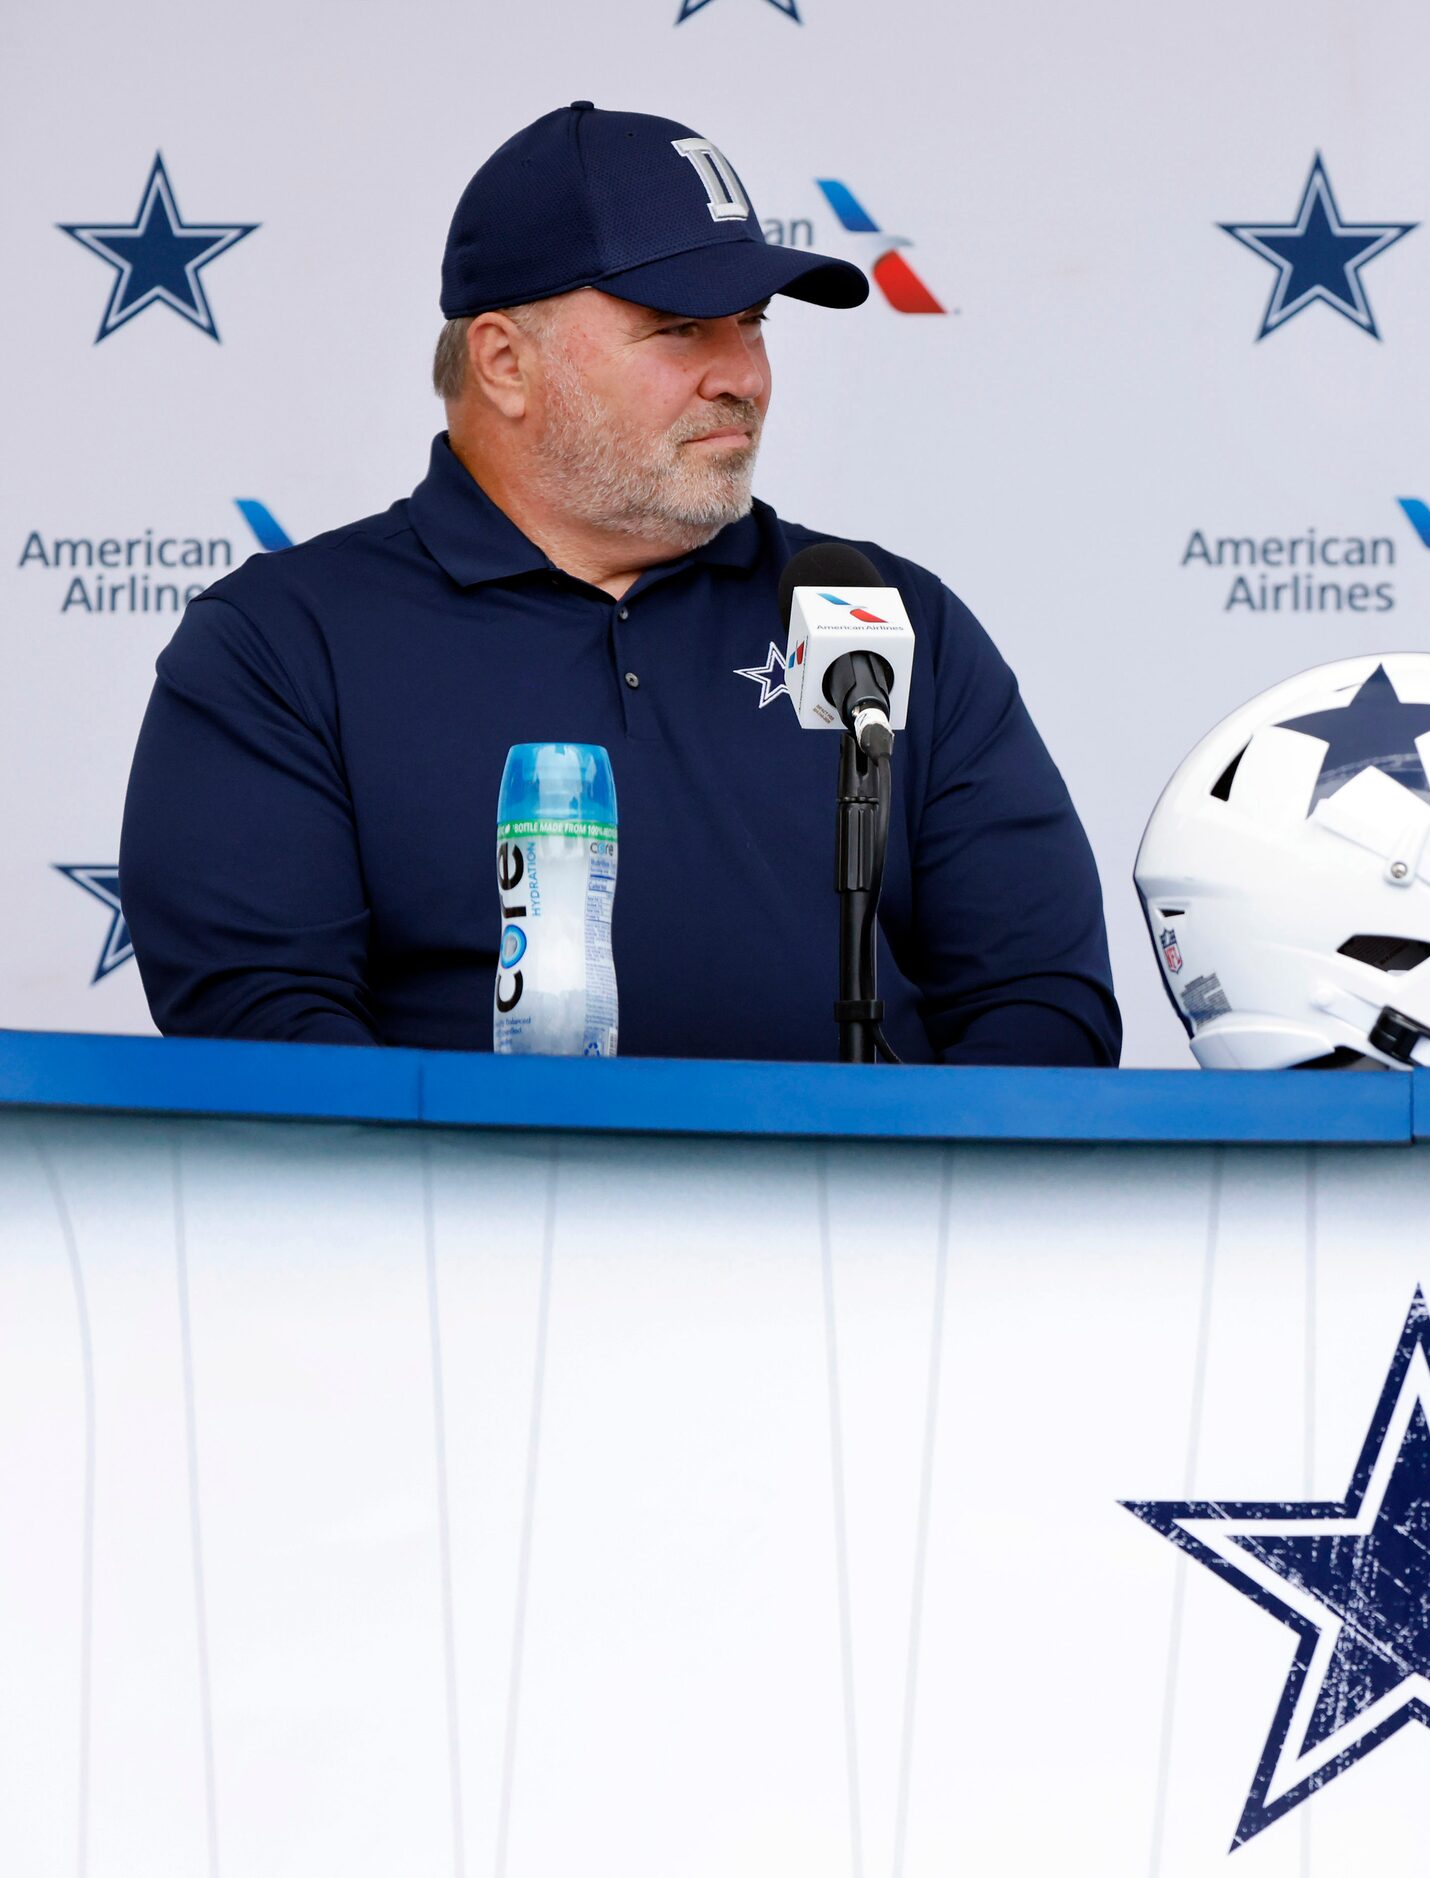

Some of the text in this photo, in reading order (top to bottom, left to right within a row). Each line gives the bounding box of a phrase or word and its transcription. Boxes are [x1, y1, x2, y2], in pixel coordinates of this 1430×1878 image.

[670, 137, 750, 223] D
[18, 529, 233, 569] American
[1181, 528, 1395, 567] American
[60, 574, 206, 613] Airline
[1225, 574, 1395, 612] Airlines
[564, 823, 587, 835] FROM
[590, 842, 614, 856] core
[527, 842, 541, 917] HYDRATION
[496, 842, 527, 1013] core
